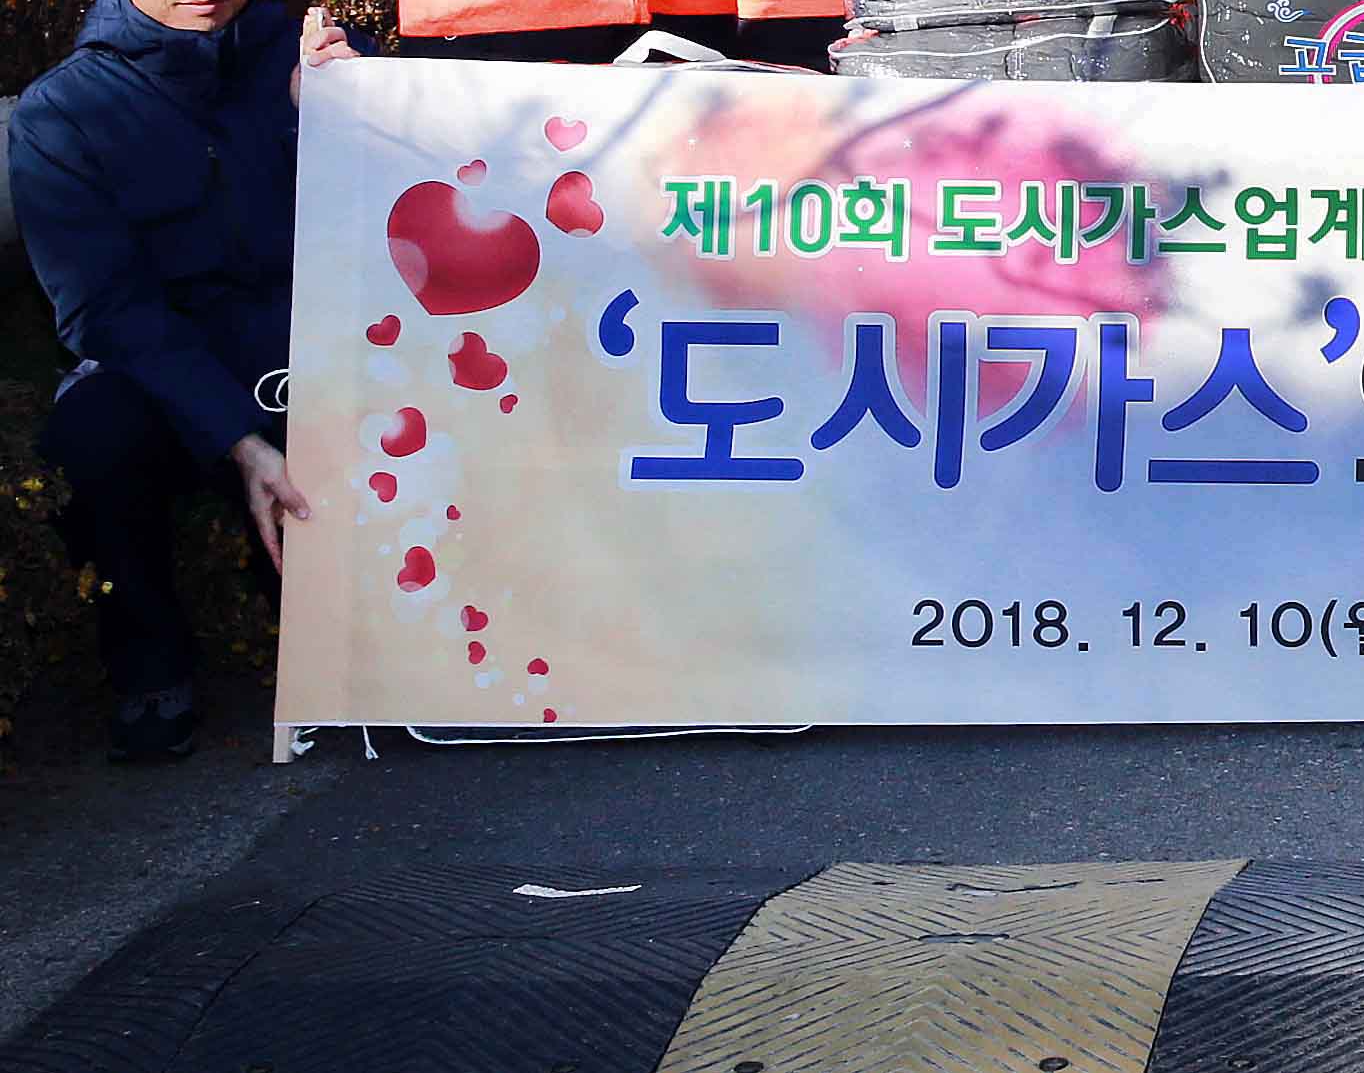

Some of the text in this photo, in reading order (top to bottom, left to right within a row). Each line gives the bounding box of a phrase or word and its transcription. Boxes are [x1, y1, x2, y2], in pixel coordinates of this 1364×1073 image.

[663, 179, 908, 258] 제10회
[911, 599, 1091, 652] 2018.
[1120, 600, 1208, 652] 12.
